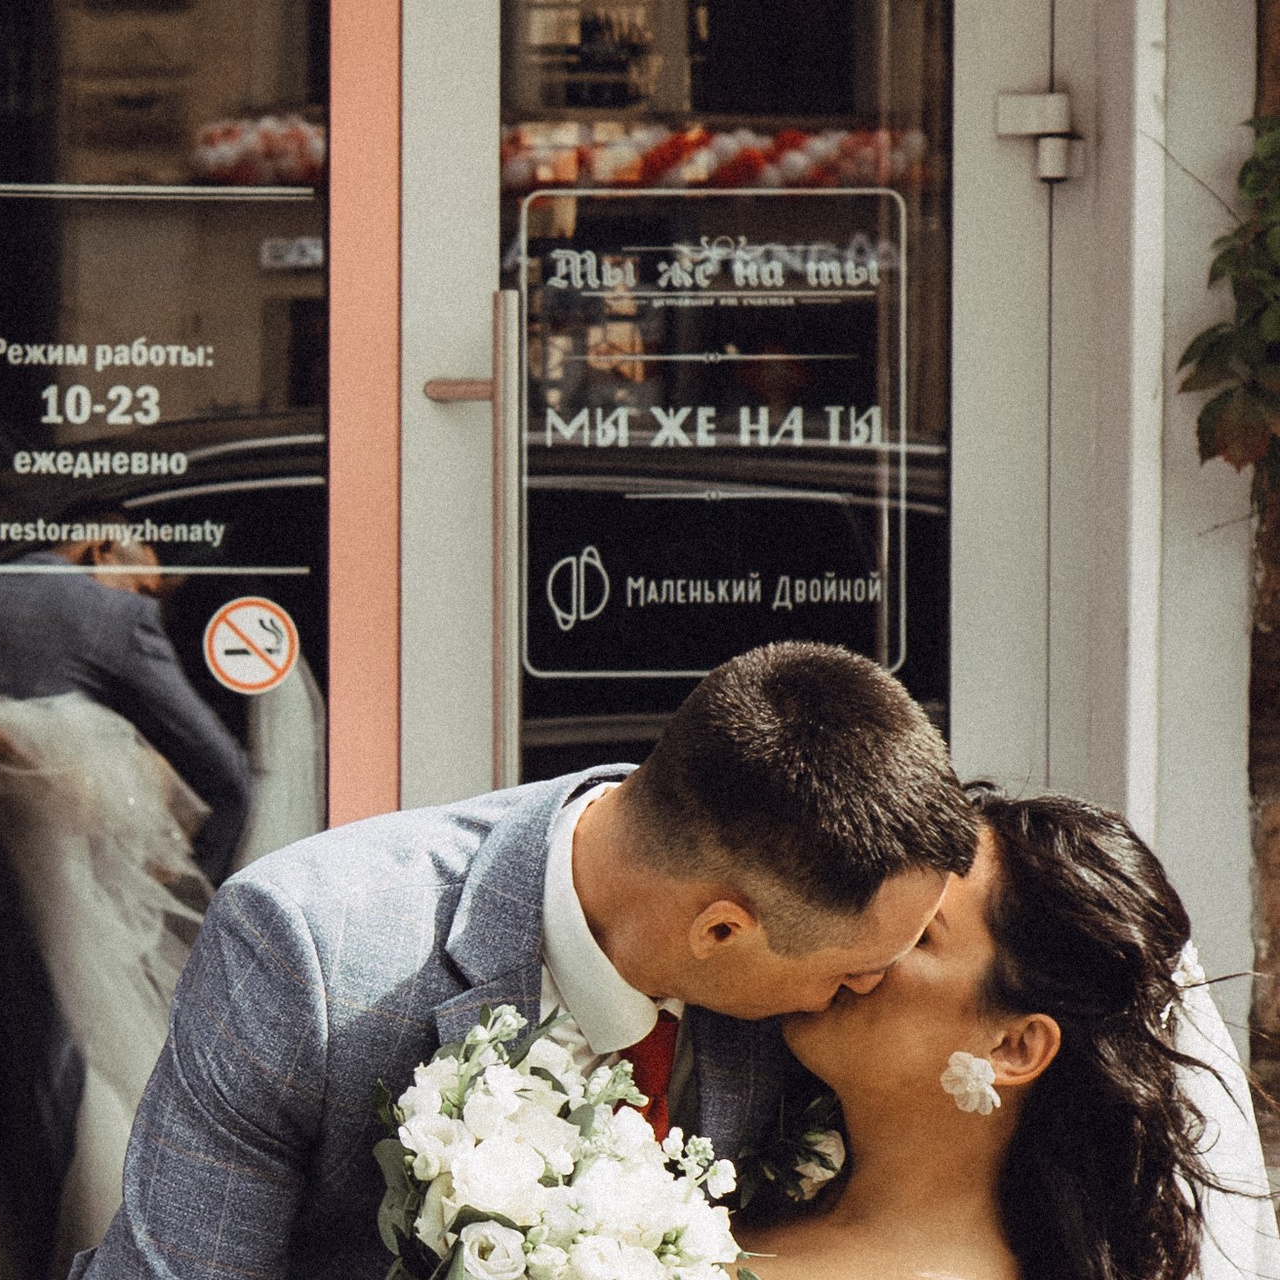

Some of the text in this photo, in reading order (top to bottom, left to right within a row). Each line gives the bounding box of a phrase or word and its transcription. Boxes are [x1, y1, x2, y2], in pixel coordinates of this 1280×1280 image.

[547, 248, 635, 289] Мы
[733, 259, 785, 287] на
[807, 260, 880, 287] ты
[95, 336, 214, 372] работы:
[40, 384, 161, 426] 10-23
[545, 405, 883, 448] МЫ ЖЕ НА ТЫ
[13, 450, 189, 479] ежедневно
[0, 518, 226, 548] restoranmyzhenaty
